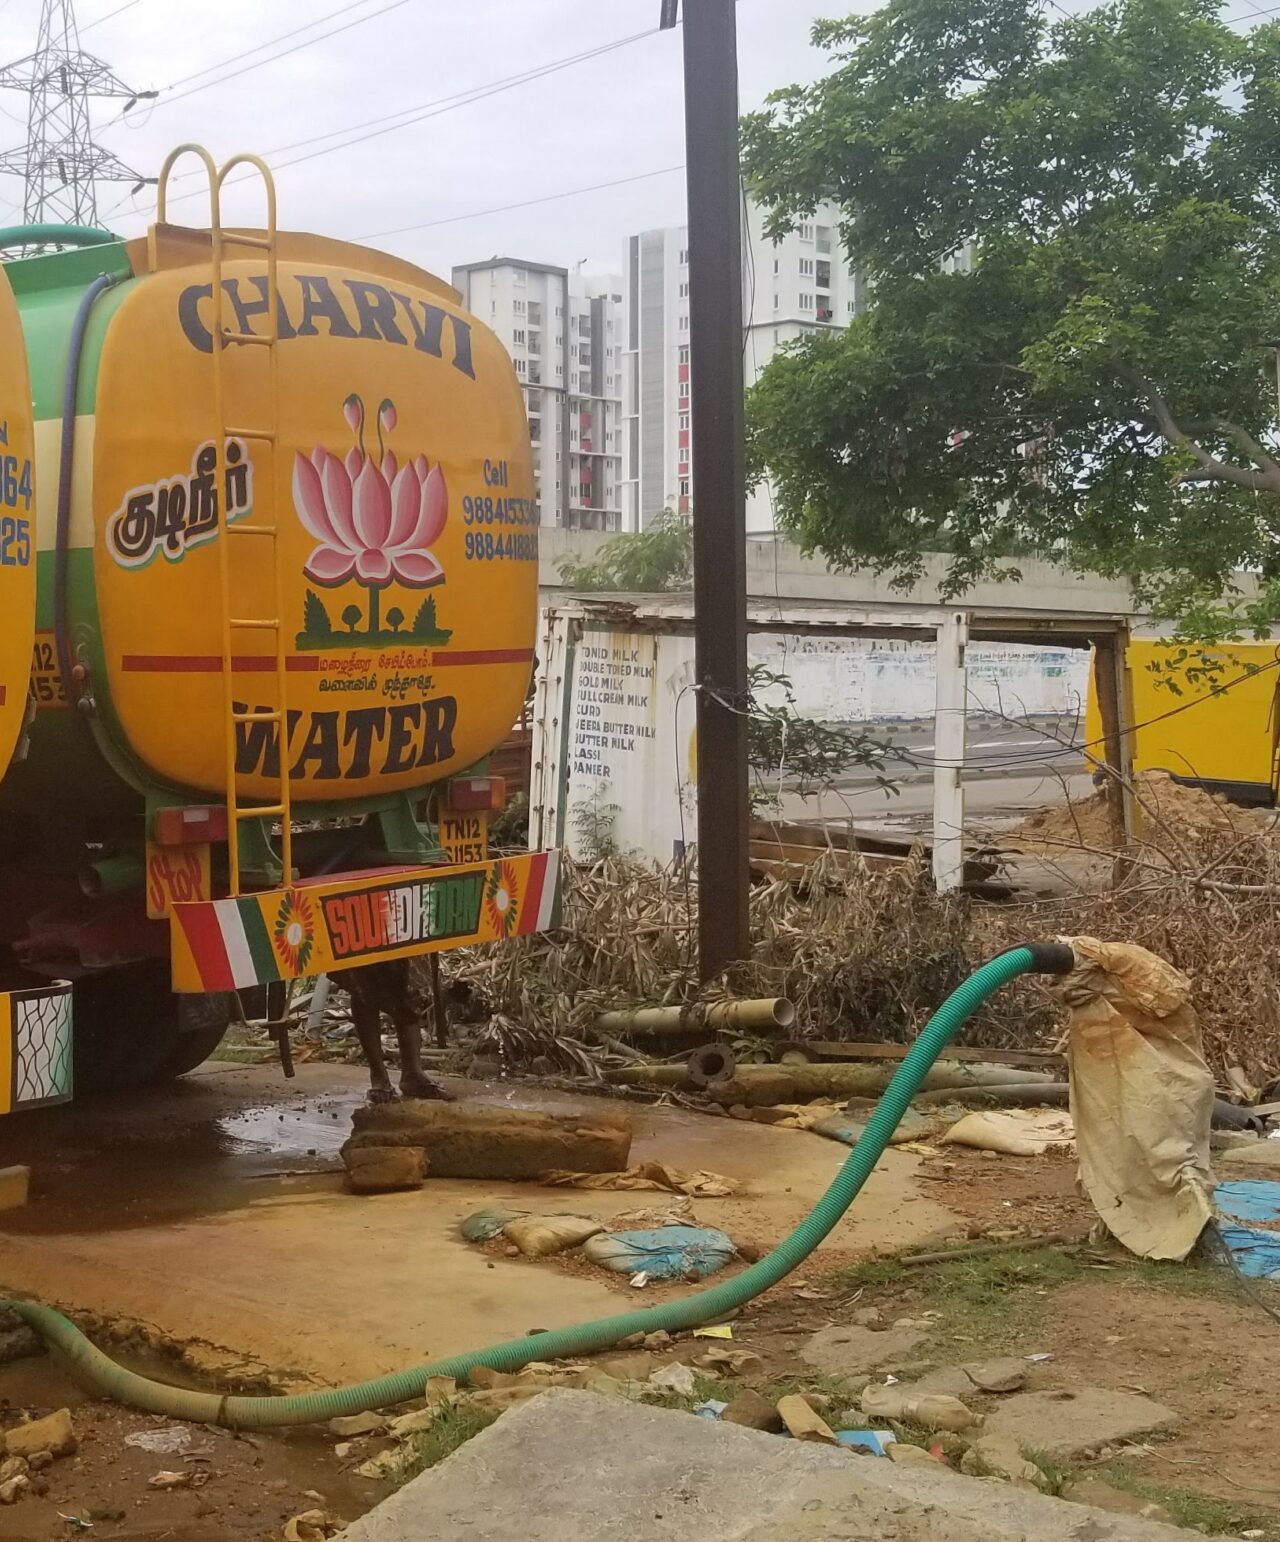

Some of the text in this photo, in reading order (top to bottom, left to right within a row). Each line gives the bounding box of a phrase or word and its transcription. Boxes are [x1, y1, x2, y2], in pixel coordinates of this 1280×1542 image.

[178, 275, 475, 380] CHARVI
[483, 458, 508, 488] Cell
[111, 440, 250, 560] குடிநீர்
[612, 649, 639, 662] MILK
[633, 666, 654, 678] MILK
[579, 676, 624, 691] GOLD MILK
[627, 694, 648, 707] MILK
[577, 703, 601, 717] CURD
[576, 718, 656, 739] JEERA BUTTER MILK
[232, 696, 458, 779] WATER
[611, 737, 635, 751] MILK
[575, 747, 601, 760] LASSI
[574, 761, 610, 778] PANEER
[443, 818, 481, 841] TN12
